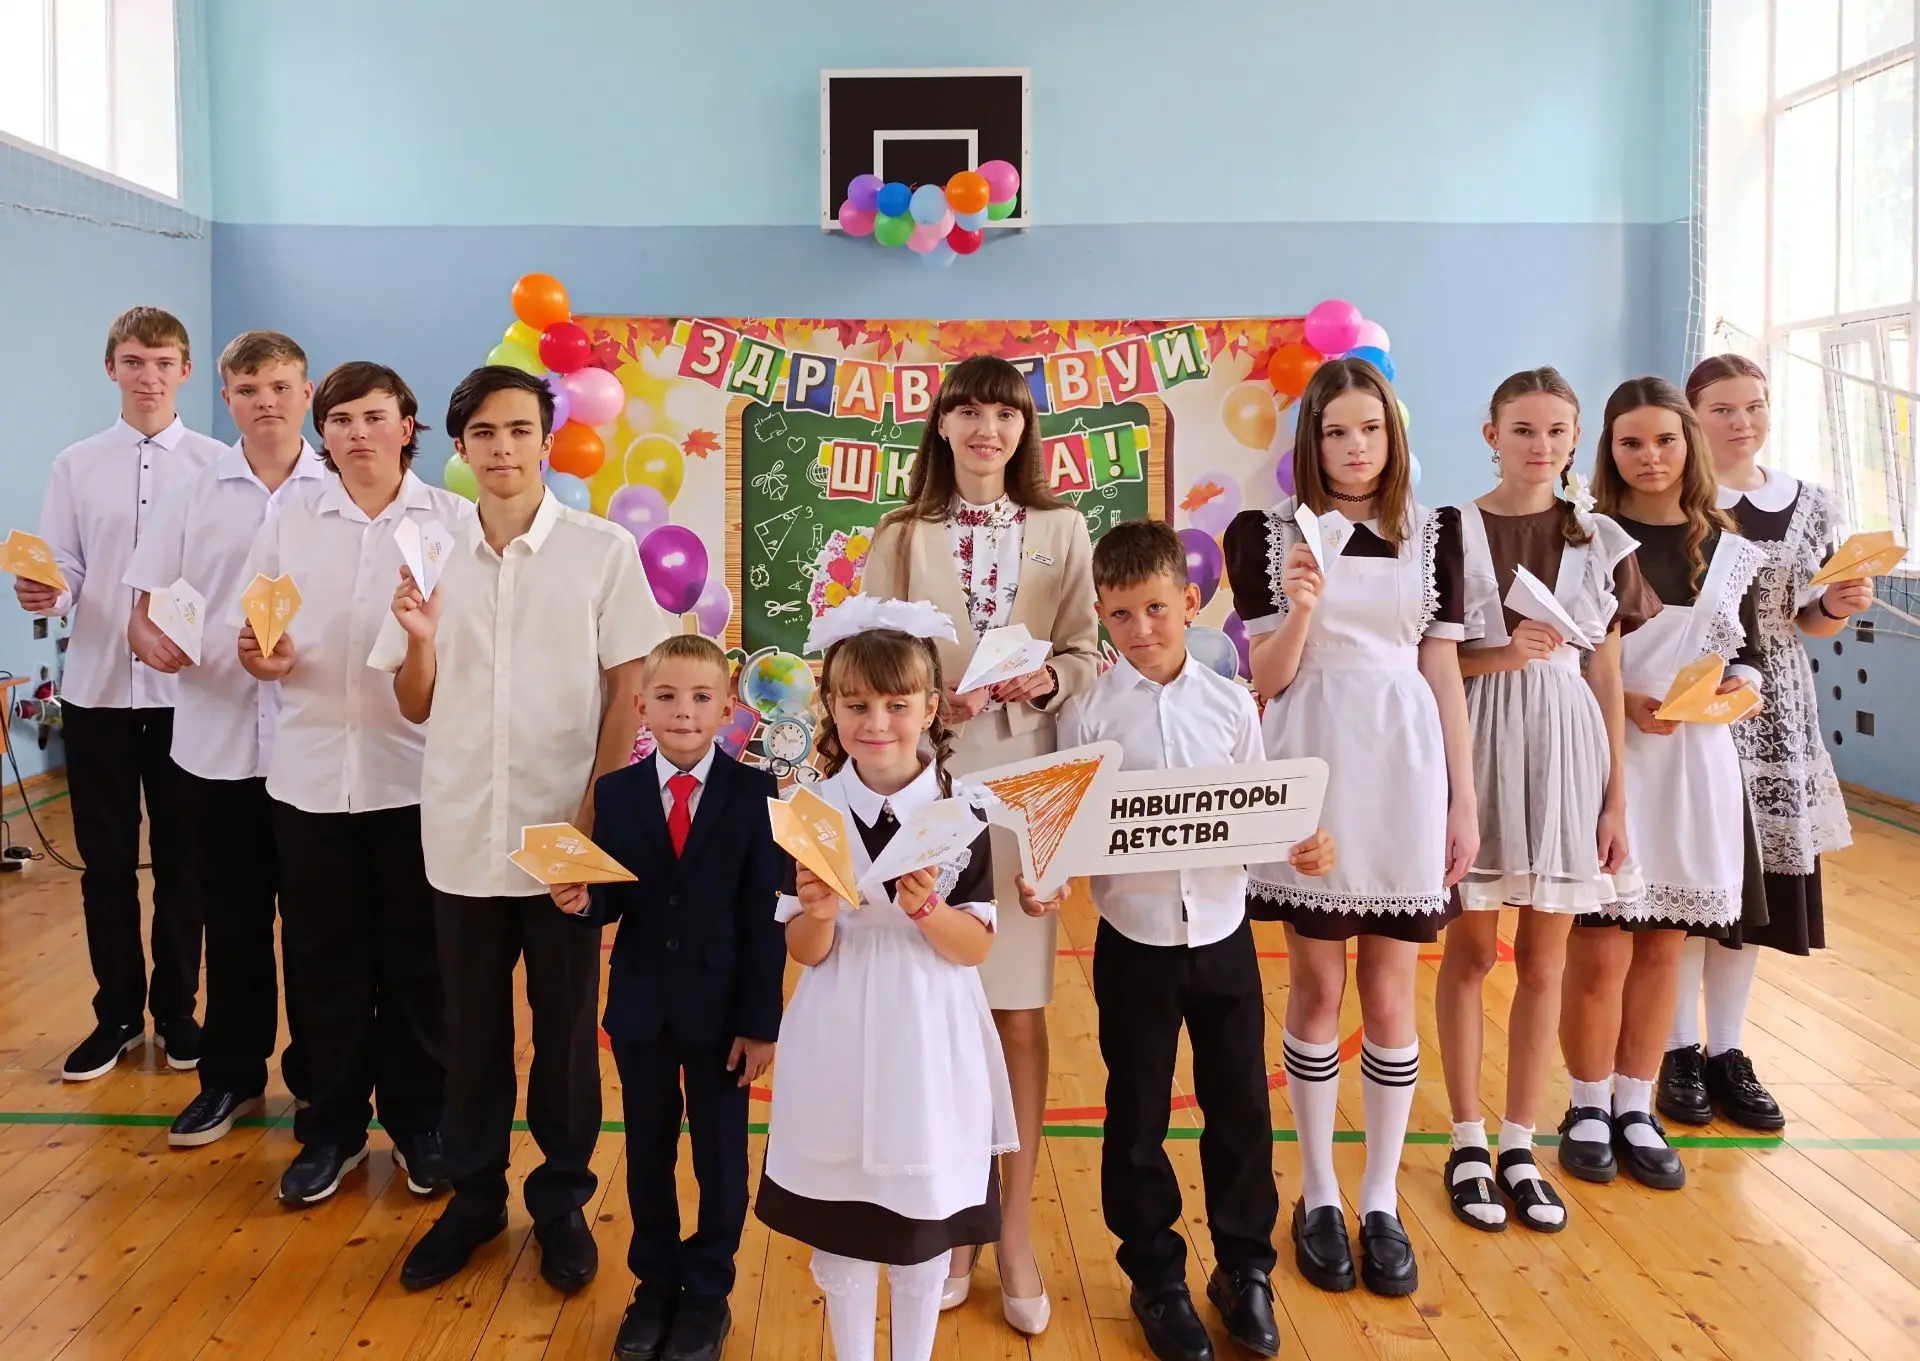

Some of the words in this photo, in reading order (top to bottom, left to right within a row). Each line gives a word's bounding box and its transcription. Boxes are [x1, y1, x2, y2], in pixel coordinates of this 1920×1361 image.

[690, 329, 1210, 413] ЗДРАВВУЙ,
[831, 431, 1121, 496] ШКА!
[1110, 784, 1288, 819] НАВИГАТОРЫ
[1109, 821, 1229, 854] ДЕТСТВА
